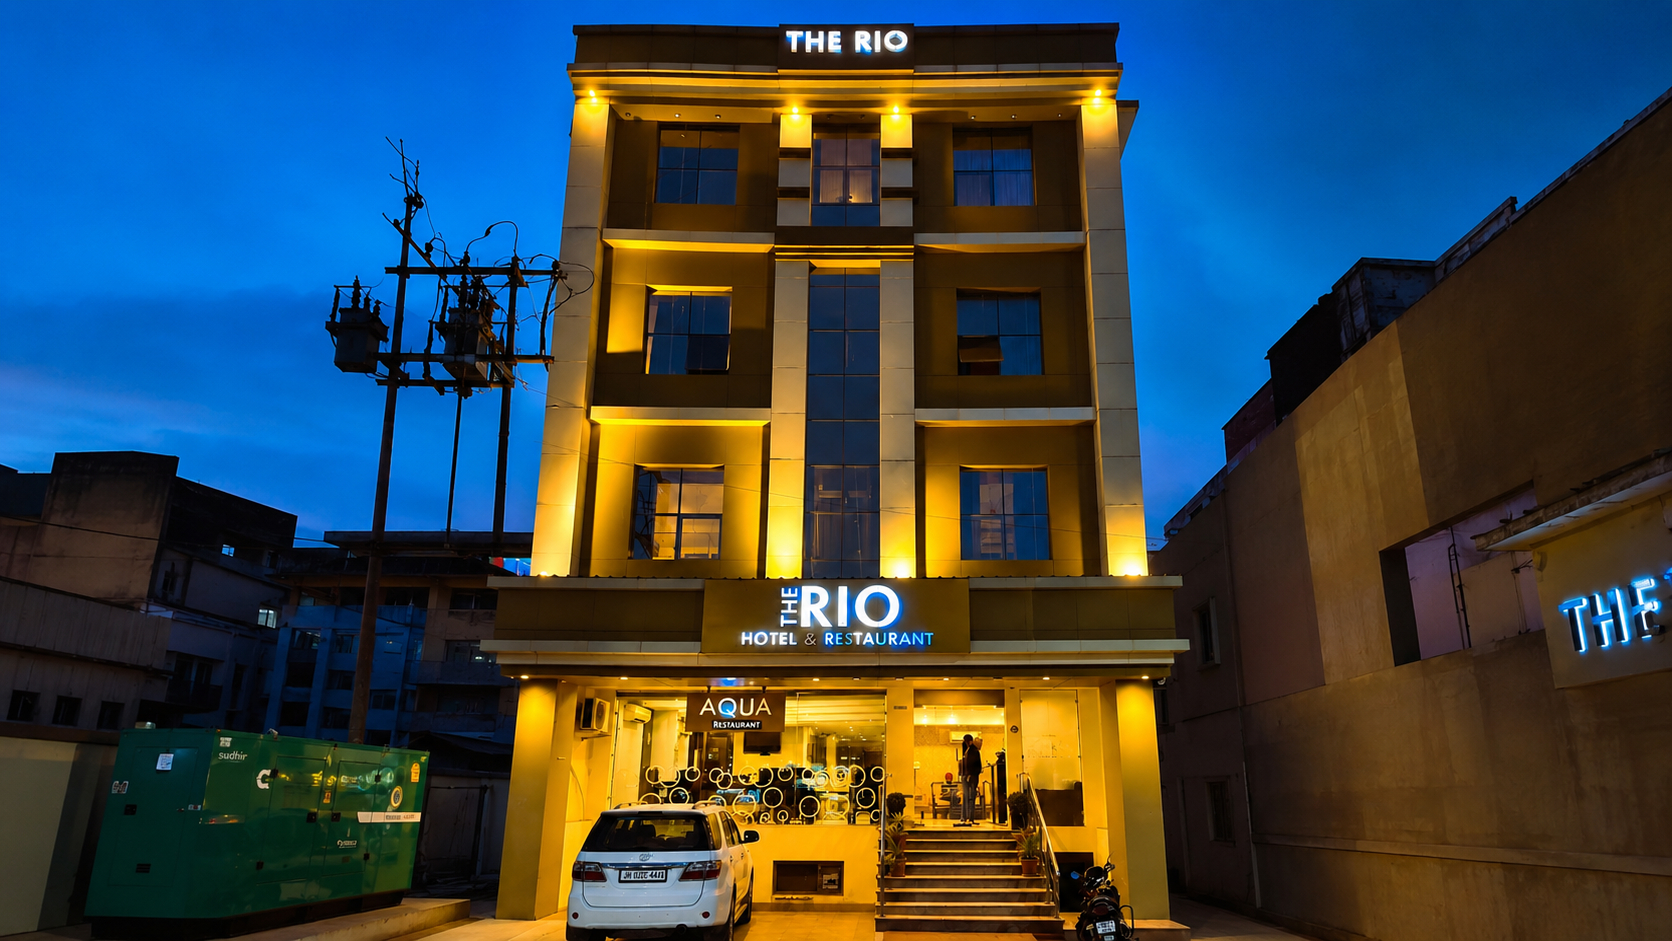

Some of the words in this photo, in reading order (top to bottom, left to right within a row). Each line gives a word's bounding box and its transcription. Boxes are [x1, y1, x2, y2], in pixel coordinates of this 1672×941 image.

[785, 30, 842, 53] THE
[854, 30, 908, 54] RIO
[780, 587, 798, 627] THE
[800, 584, 901, 628] RIO
[1558, 577, 1659, 653] THE
[741, 632, 797, 646] HOTEL
[804, 633, 817, 646] &
[824, 632, 934, 646] RESTAURANT
[699, 697, 772, 718] AQUA
[713, 720, 761, 729] RESTAURANT
[218, 751, 248, 760] sudhir
